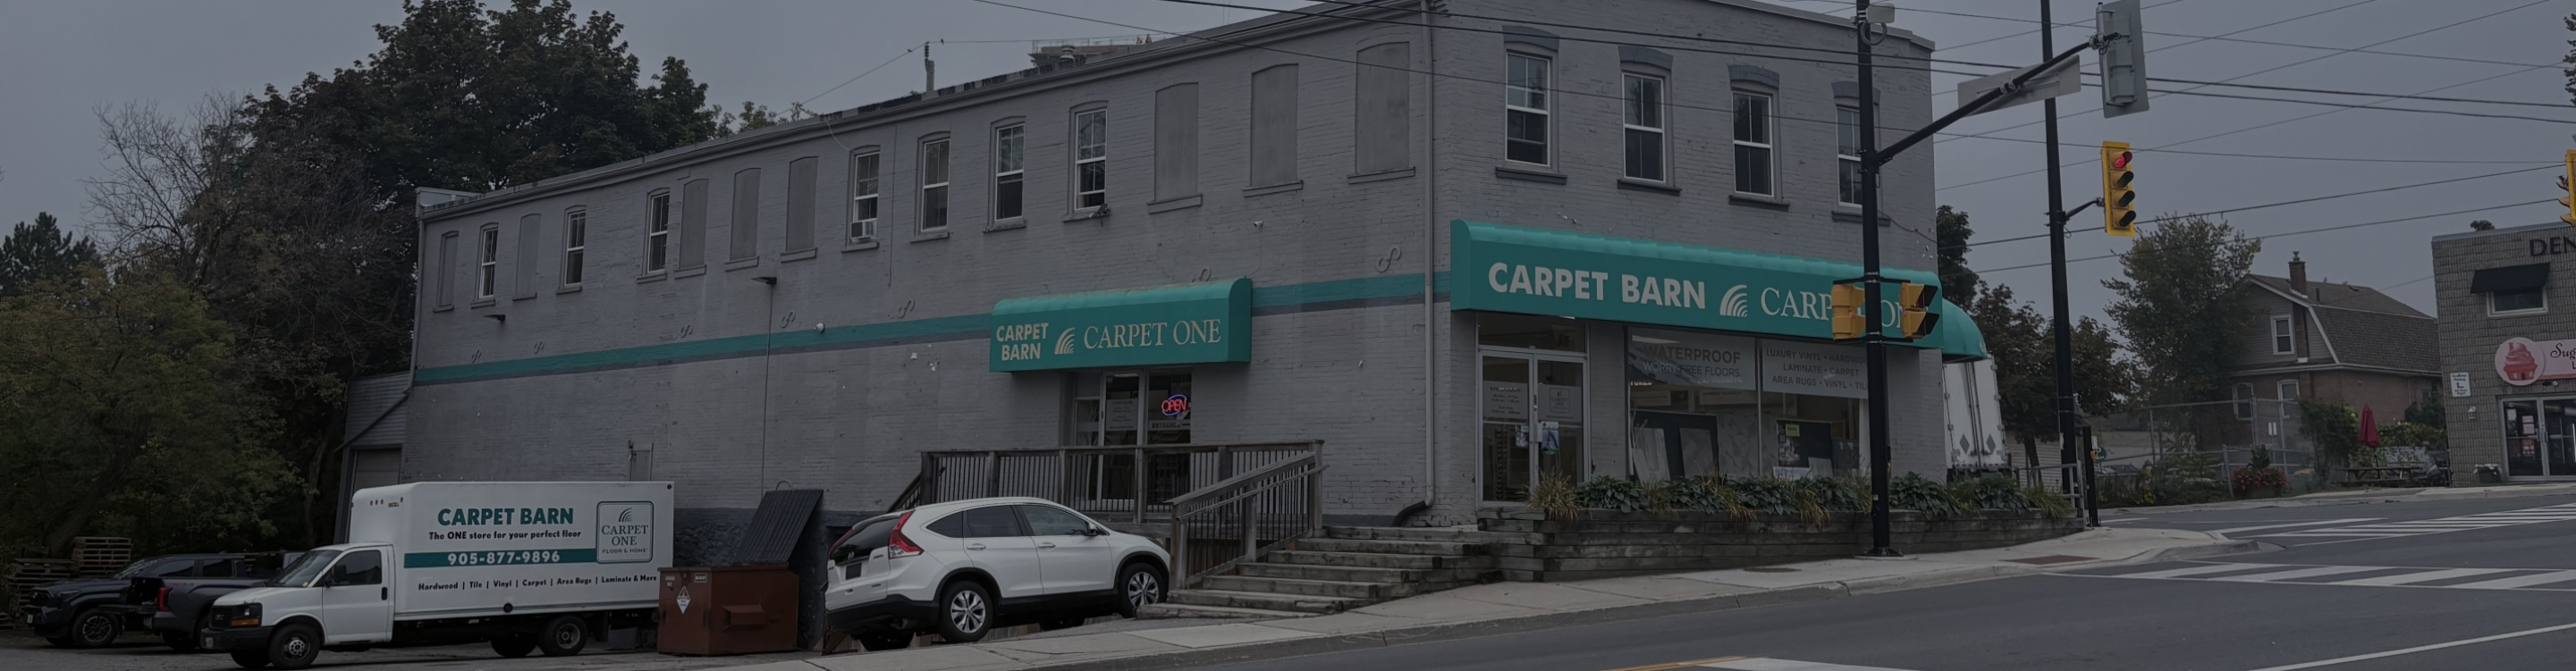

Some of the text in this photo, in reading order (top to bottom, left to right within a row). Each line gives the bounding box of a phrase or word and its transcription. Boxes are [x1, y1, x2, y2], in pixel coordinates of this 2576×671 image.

[1488, 261, 1705, 309] CARPET BARN
[1761, 287, 1865, 321] CARP
[1084, 318, 1222, 348] CARPET ONE
[996, 323, 1049, 361] CARPET BARN
[1643, 344, 1741, 364] WATERPROOF
[1766, 348, 1867, 365] LUXURY VINYL HARDWOO
[1643, 361, 1743, 378] WORRY-FREE FLOORS.
[1783, 363, 1860, 377] LAMINATE CARPET
[1772, 375, 1868, 390] AREA RUGS VINYL TIL
[1161, 398, 1187, 413] OPEN
[437, 507, 573, 525] CARPET BARN
[429, 530, 581, 541] The ONE store for your perfect floor
[602, 524, 649, 535] CARPET
[612, 535, 638, 546] ONE
[447, 550, 561, 566] 905-877-9896
[418, 582, 459, 591] Hardwood
[469, 581, 483, 589] Tile
[494, 580, 512, 588] Vinyl
[522, 578, 547, 587] Carpet
[557, 577, 573, 585] Area
[576, 576, 592, 585] Rugs
[602, 575, 631, 583] Laminate
